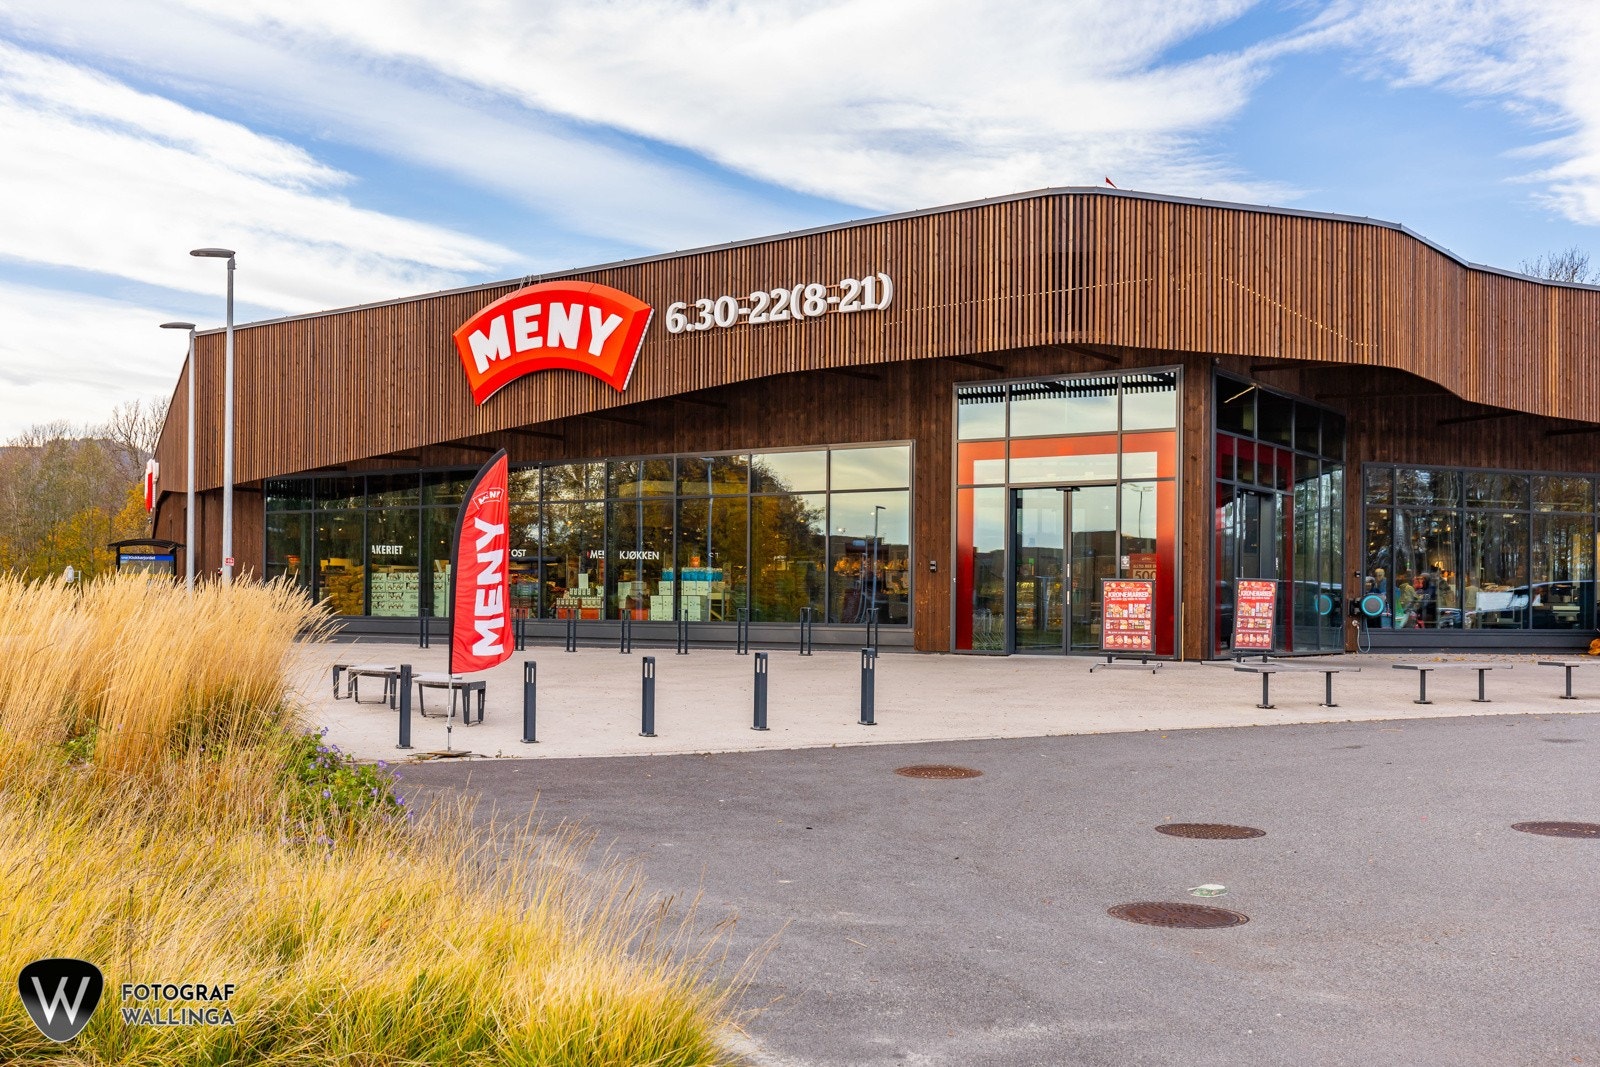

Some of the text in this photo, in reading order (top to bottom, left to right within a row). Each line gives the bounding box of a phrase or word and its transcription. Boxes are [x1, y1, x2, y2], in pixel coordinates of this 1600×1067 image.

[665, 272, 895, 335] 6.30-22(8-21)
[467, 301, 624, 375] MENY
[510, 548, 527, 558] OST
[618, 550, 660, 561] KJØKKEN
[472, 517, 505, 656] MENY
